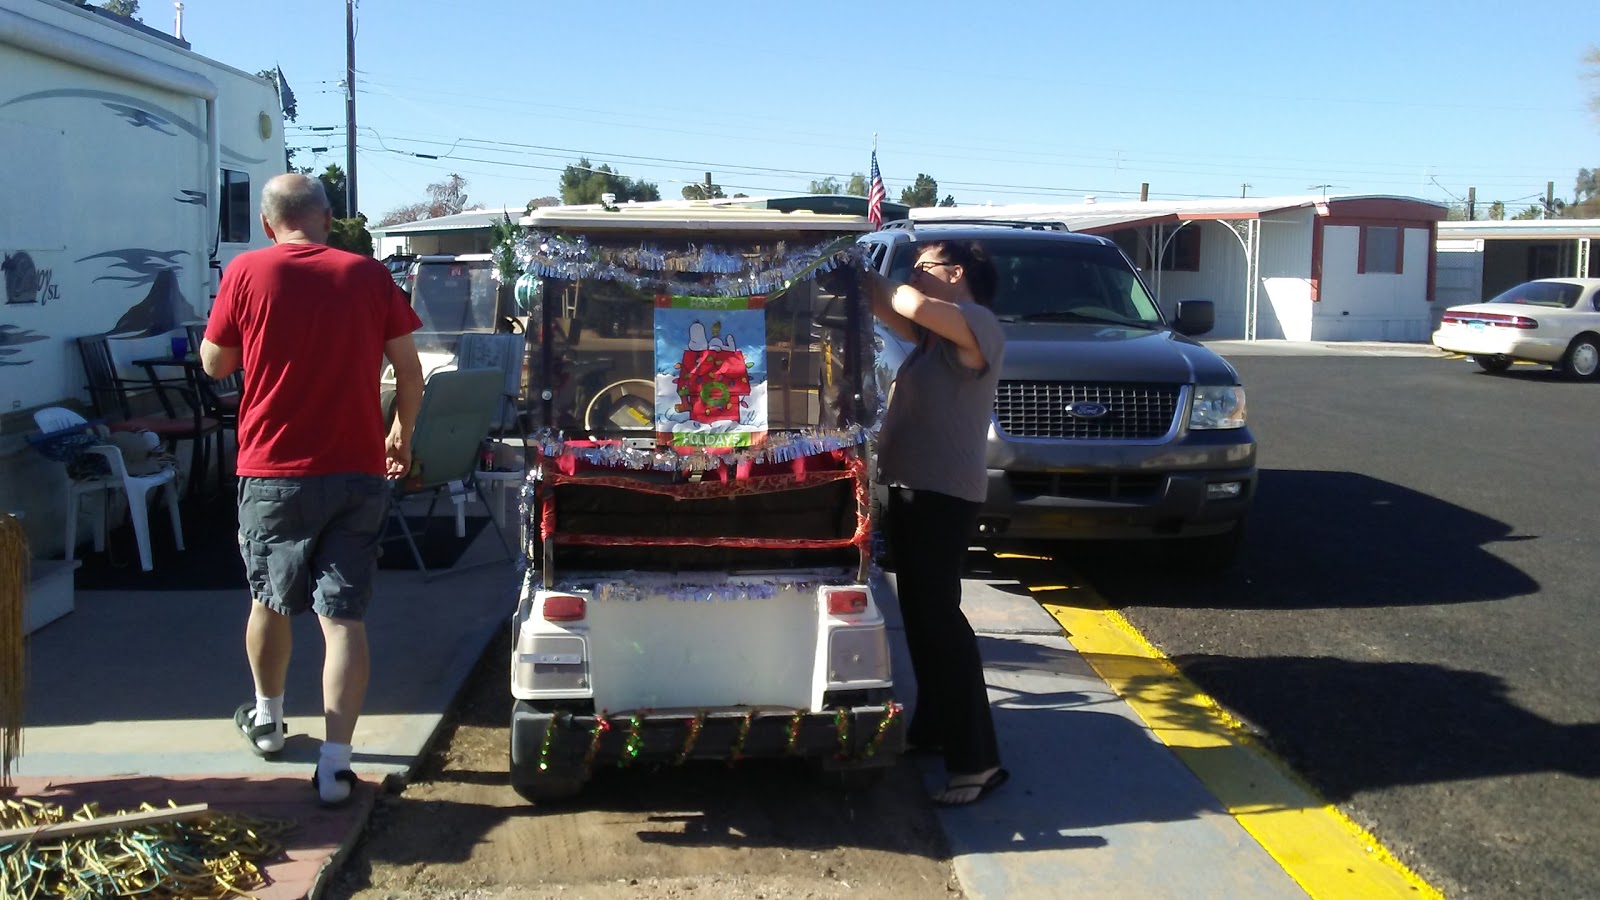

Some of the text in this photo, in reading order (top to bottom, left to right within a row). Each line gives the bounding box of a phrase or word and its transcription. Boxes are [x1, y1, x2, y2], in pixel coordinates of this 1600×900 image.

[47, 284, 60, 300] SL
[689, 299, 731, 309] HAPPY
[683, 432, 740, 446] HOLIDAYS
